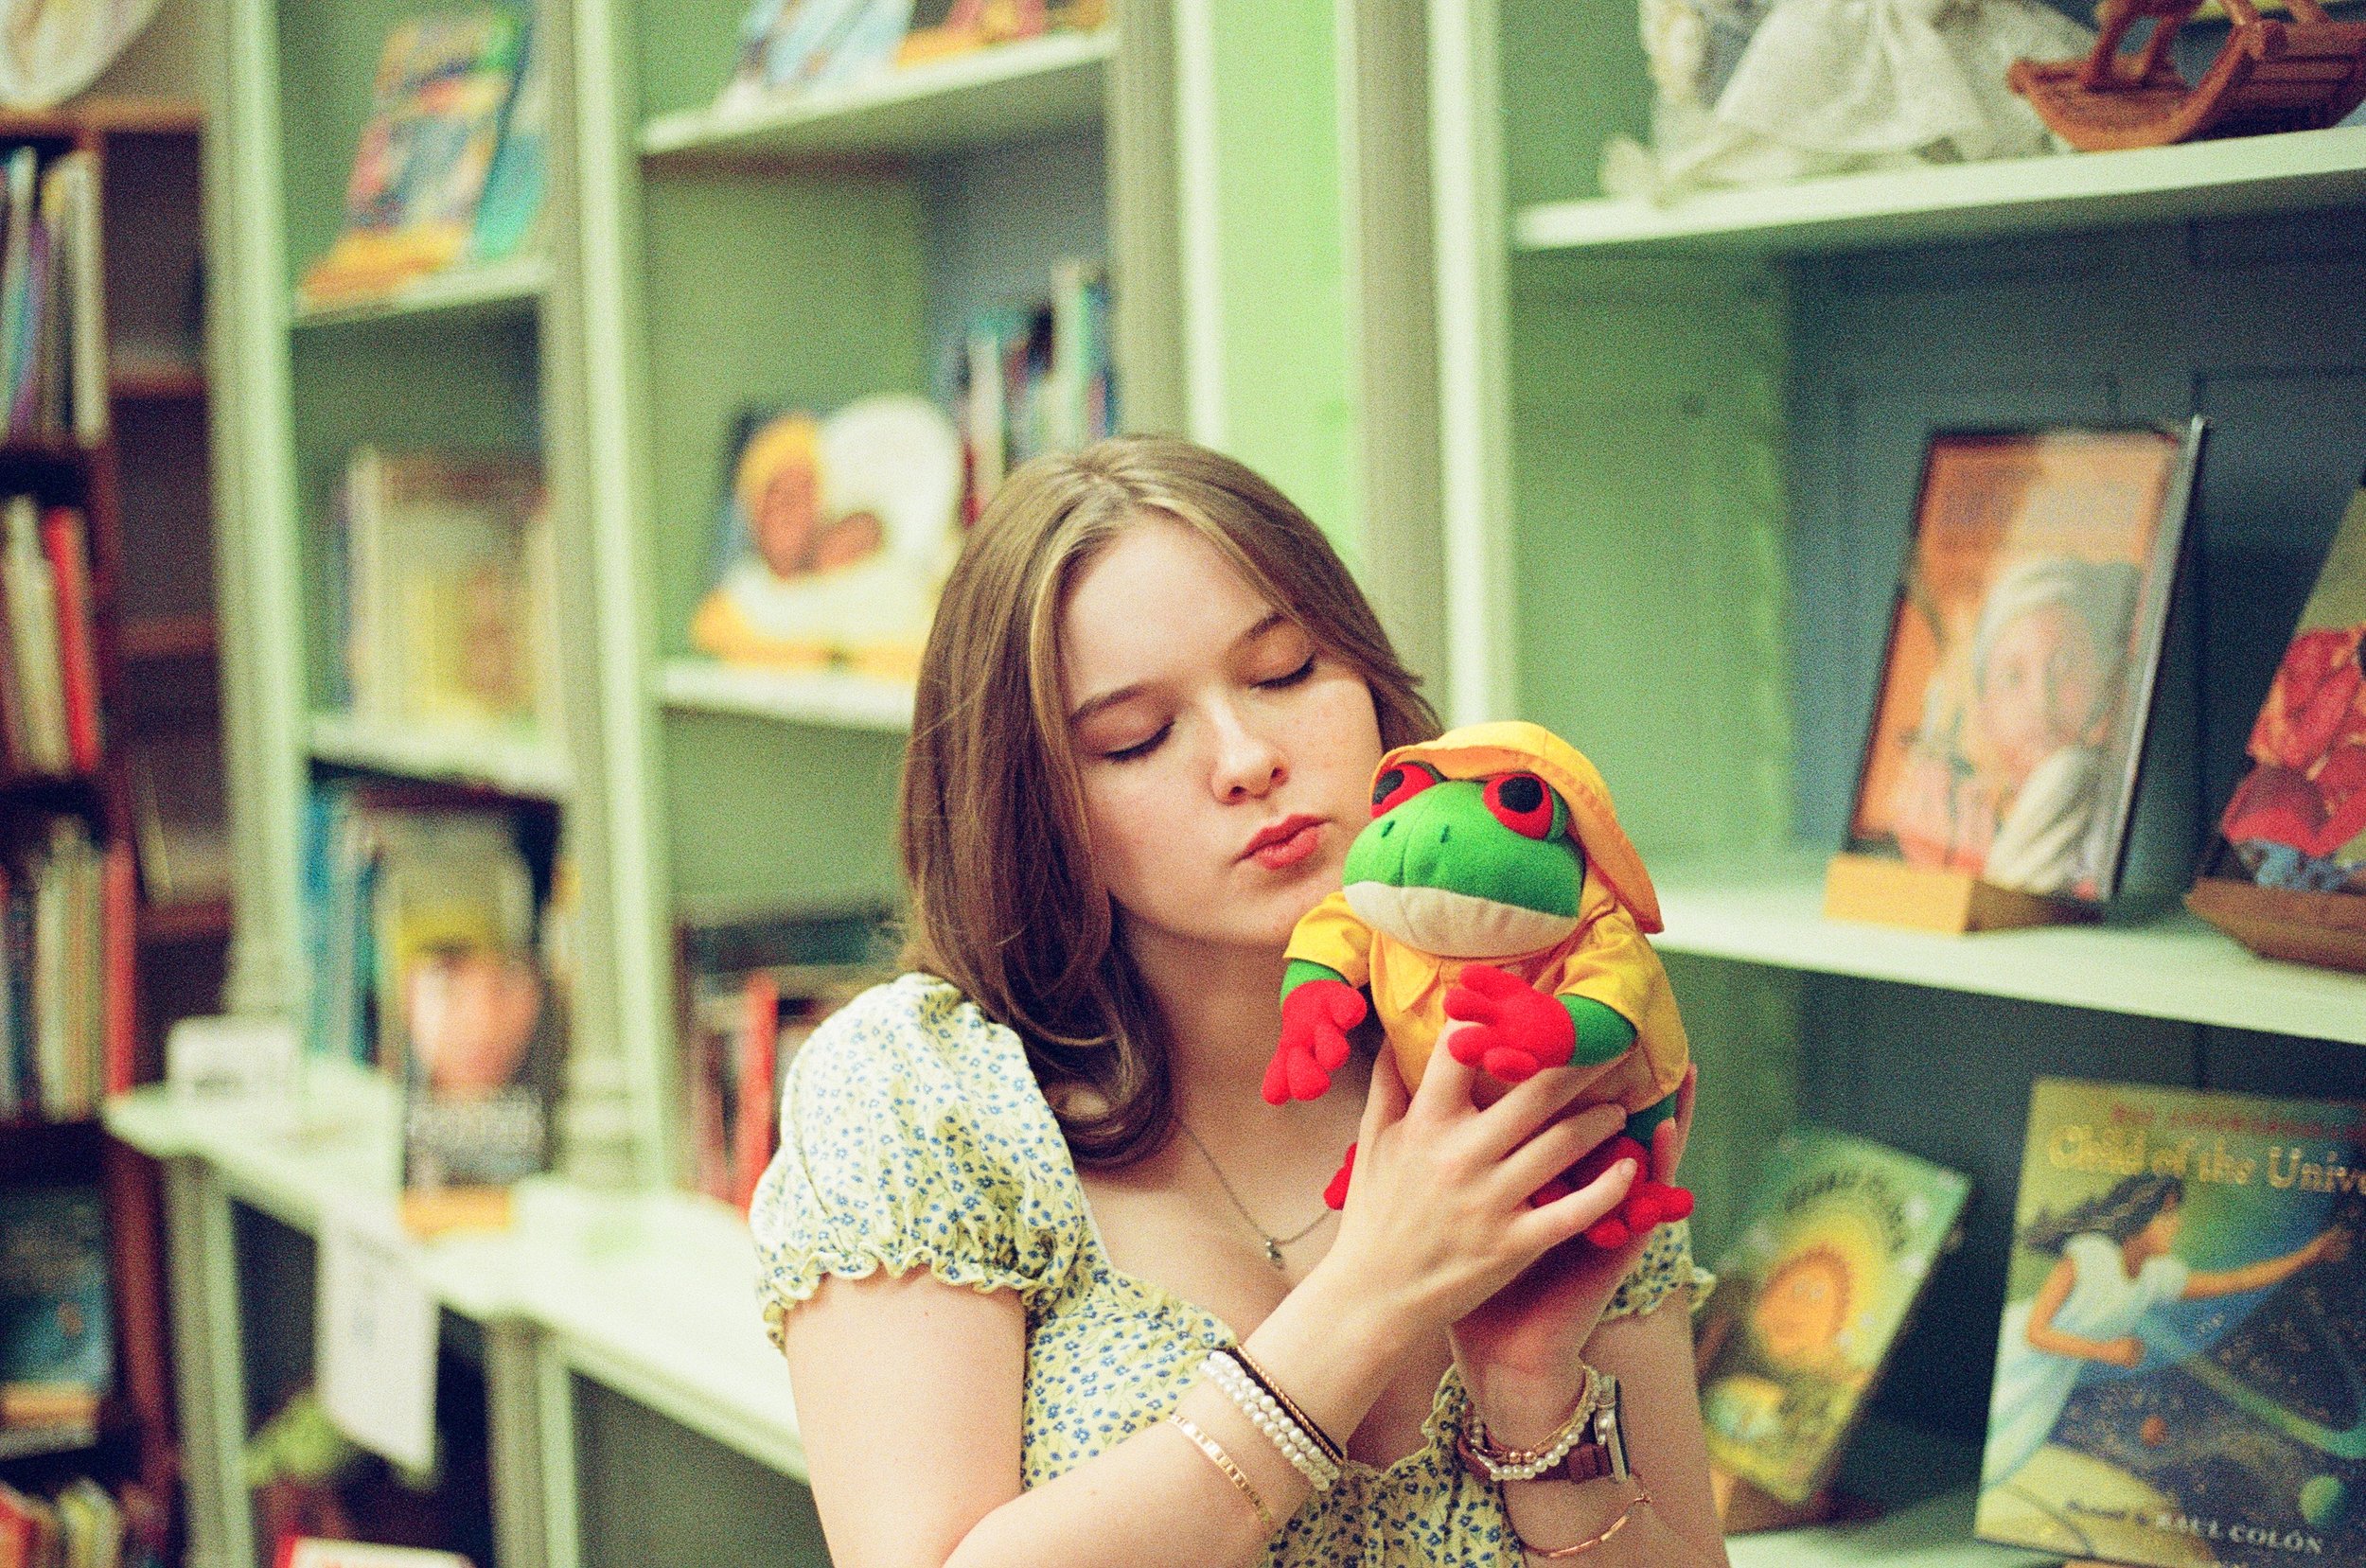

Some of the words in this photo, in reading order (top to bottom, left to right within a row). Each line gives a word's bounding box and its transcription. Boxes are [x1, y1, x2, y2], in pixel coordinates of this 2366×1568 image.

[2049, 1124, 2145, 1175] Child
[2151, 1137, 2197, 1176] of
[2198, 1138, 2256, 1185] the
